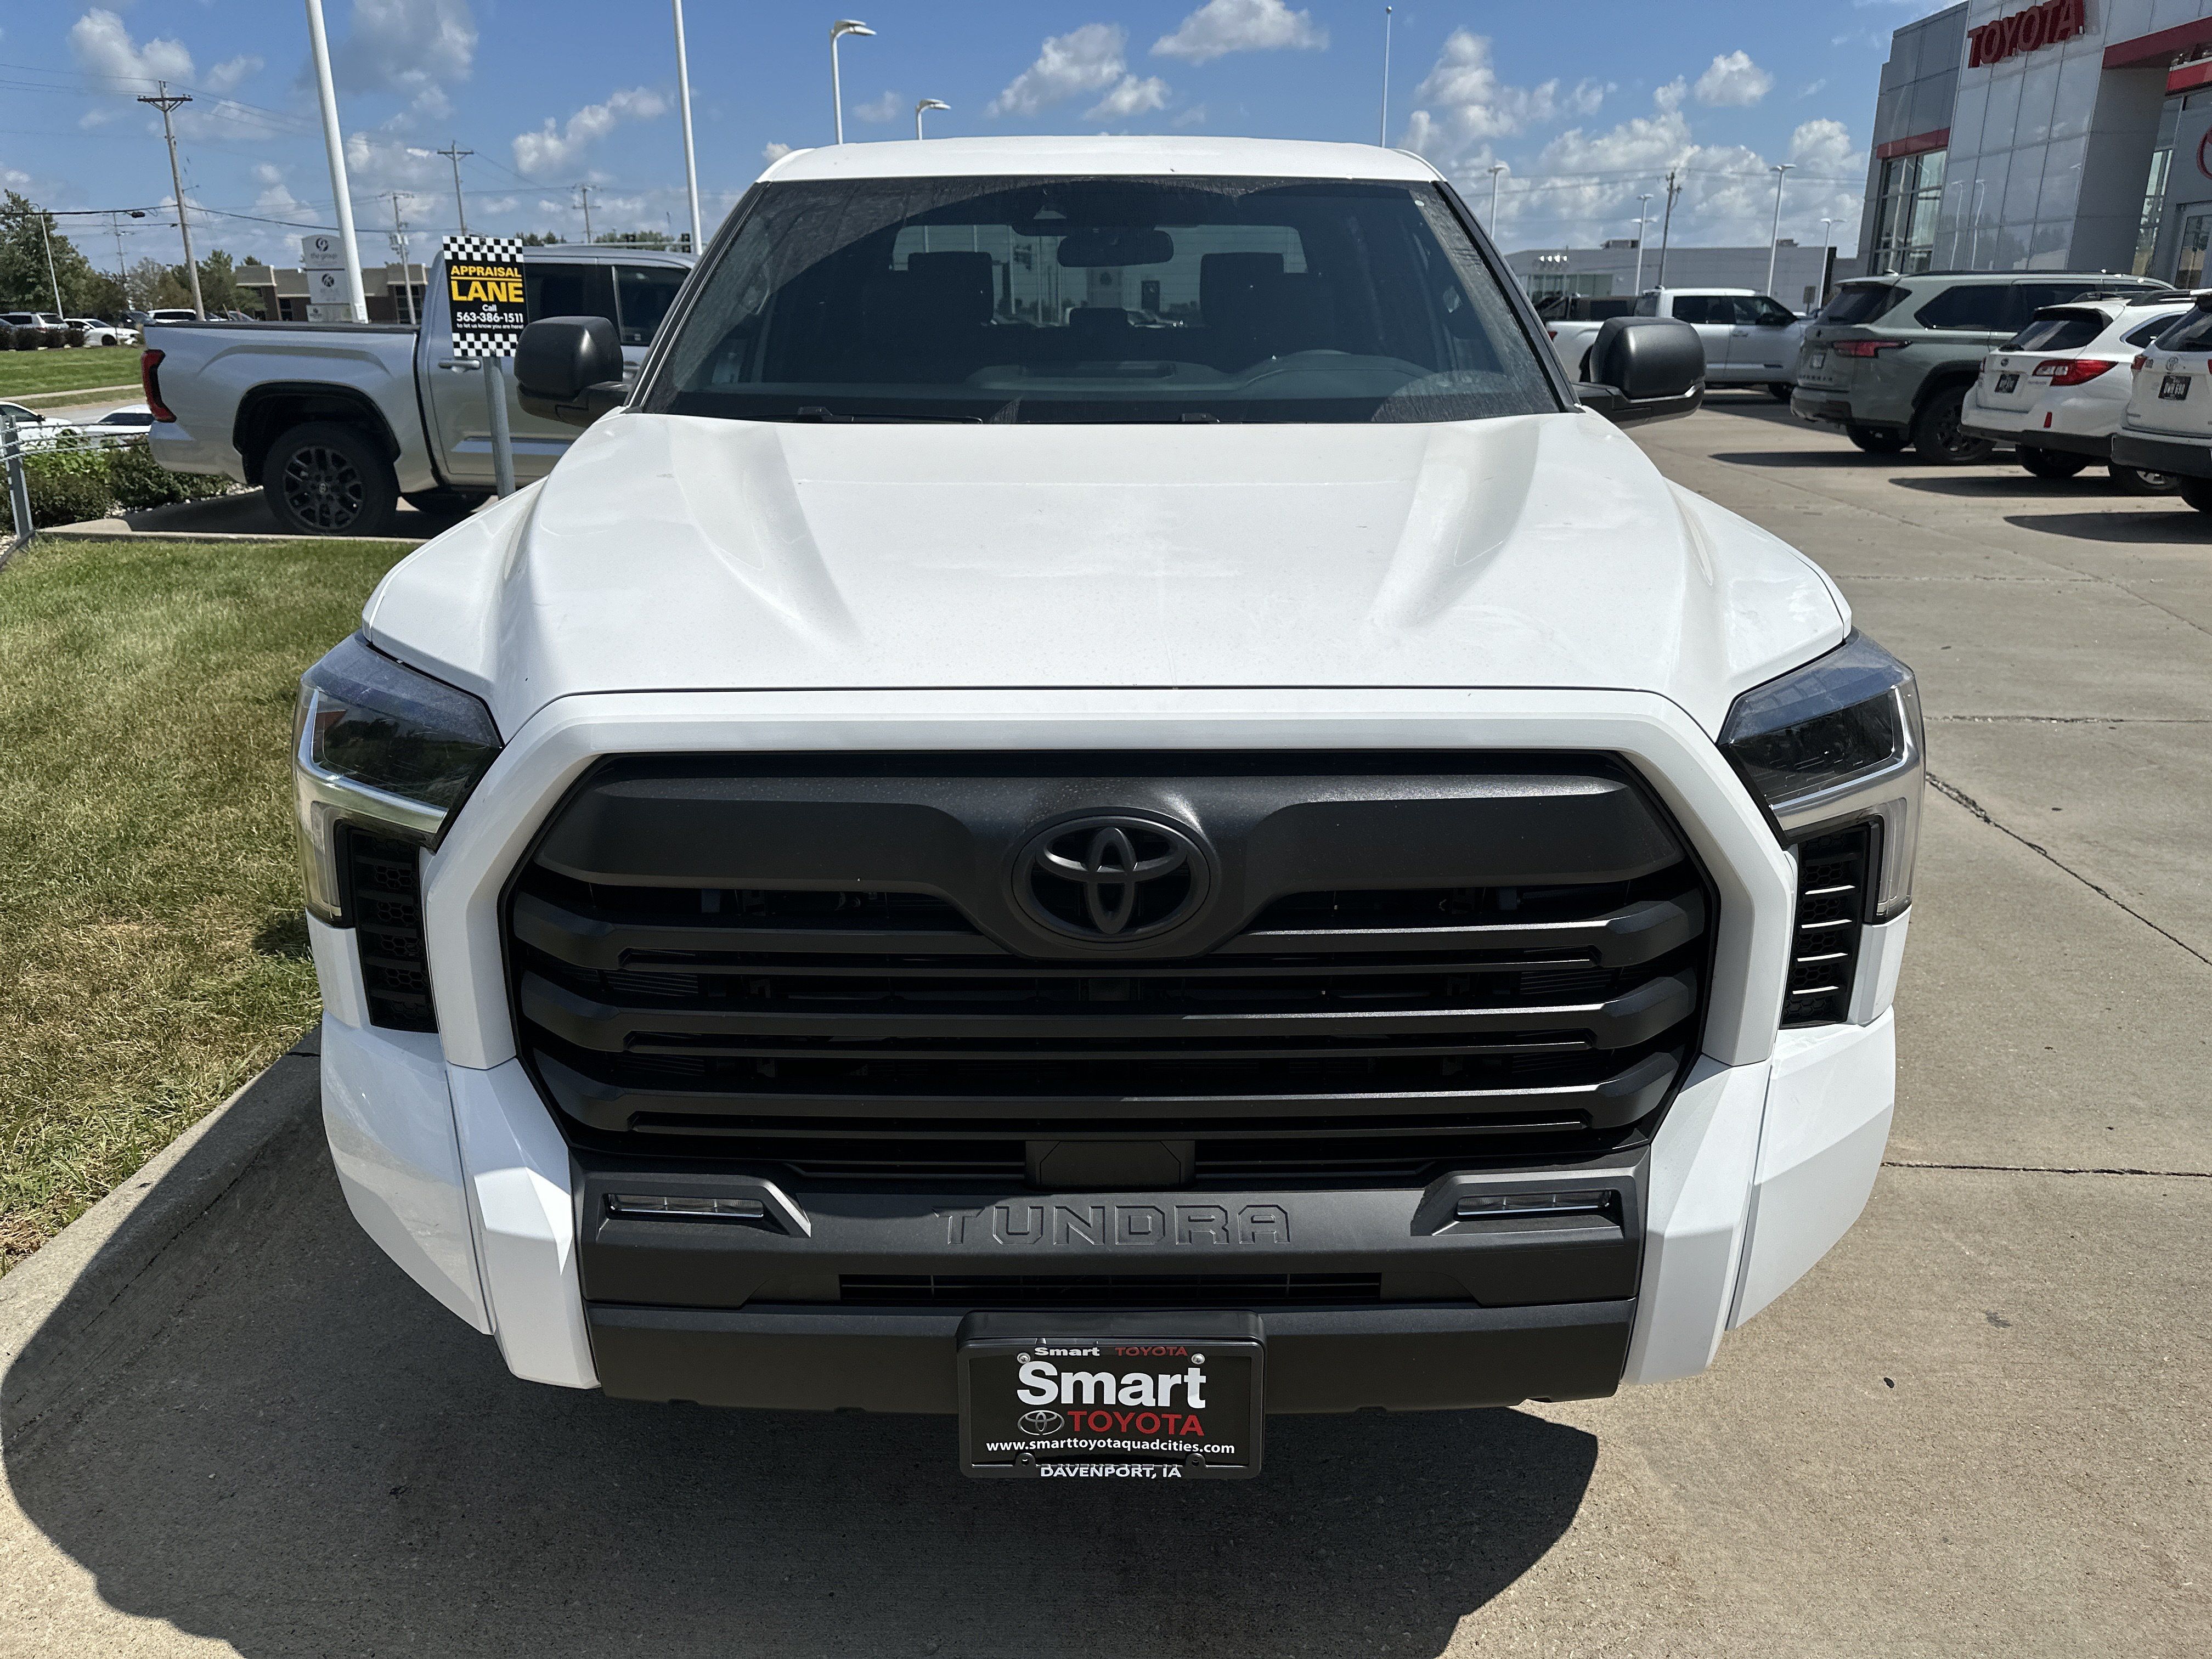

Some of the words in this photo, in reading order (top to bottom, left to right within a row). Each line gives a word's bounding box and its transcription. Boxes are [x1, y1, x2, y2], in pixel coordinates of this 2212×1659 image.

[1967, 0, 2085, 69] TOYOTA
[451, 266, 522, 278] APPRAISAL
[451, 280, 524, 303] LANE
[456, 312, 524, 323] 563-386-1511
[933, 1205, 1291, 1245] TUNDRA
[1034, 1346, 1100, 1357] Smart
[1114, 1346, 1188, 1357] TOYOTA
[1017, 1361, 1206, 1409] Smart
[1067, 1410, 1205, 1436] TOYOTA
[986, 1437, 1235, 1454] www.smarttoyotaquadcities.com
[1040, 1465, 1158, 1479] DAVENPORT,
[1162, 1465, 1182, 1479] IA
